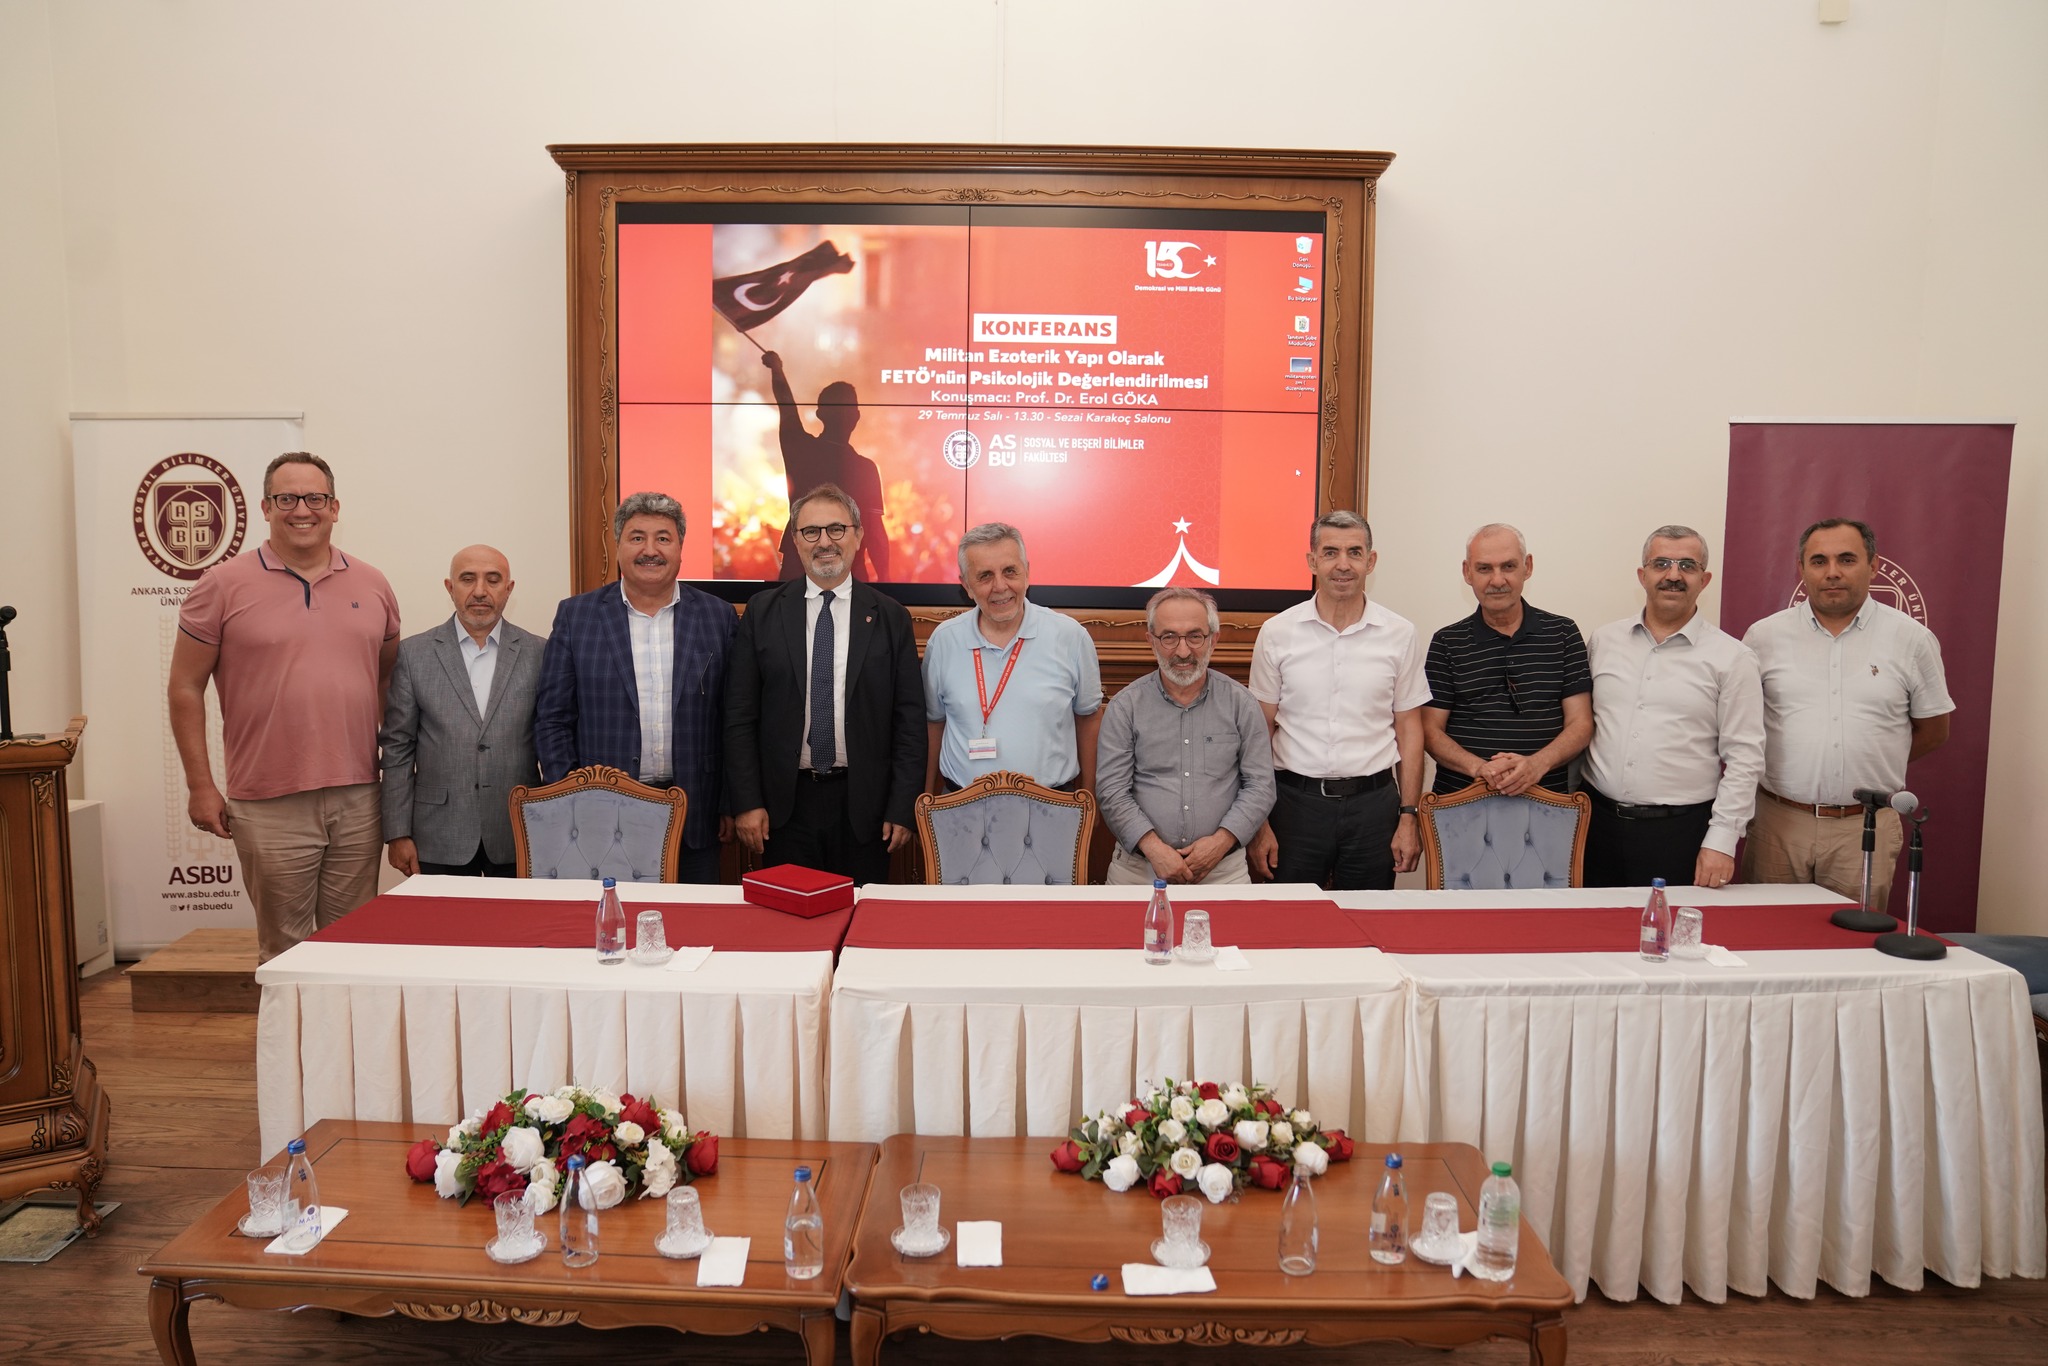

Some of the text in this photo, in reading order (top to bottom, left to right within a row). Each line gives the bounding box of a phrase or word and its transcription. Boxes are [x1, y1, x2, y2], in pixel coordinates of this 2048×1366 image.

[981, 320, 1112, 337] KONFERANS
[925, 347, 1165, 368] Militan Ezoterik Yapı Olarak
[881, 366, 1209, 390] FETÖ'nün Psikolojik Değerlendirilmesi
[931, 390, 1159, 406] Konuşmacı: Prof. Dr. Erol GÖKA
[918, 410, 933, 420] 29
[935, 410, 980, 421] Temmuz
[983, 411, 1003, 421] Salı
[1014, 411, 1044, 422] 13.30
[1054, 412, 1083, 423] Sezai
[1086, 412, 1131, 426] Karakoç
[1134, 413, 1171, 424] Salonu
[989, 434, 1017, 450] AS
[1023, 436, 1145, 451] SOSYAL VE BEŞERİ BİLİMLER
[1023, 450, 1068, 463] FAKÜLTESİ
[134, 454, 246, 576] ANKARA SOSYAL BİLİMLER ÜNİVERSİT
[131, 586, 193, 596] ANKARA SOS
[168, 865, 233, 885] ASBÜ
[161, 890, 241, 899] www.asbu.edu.tr
[192, 902, 233, 911] asbuedu
